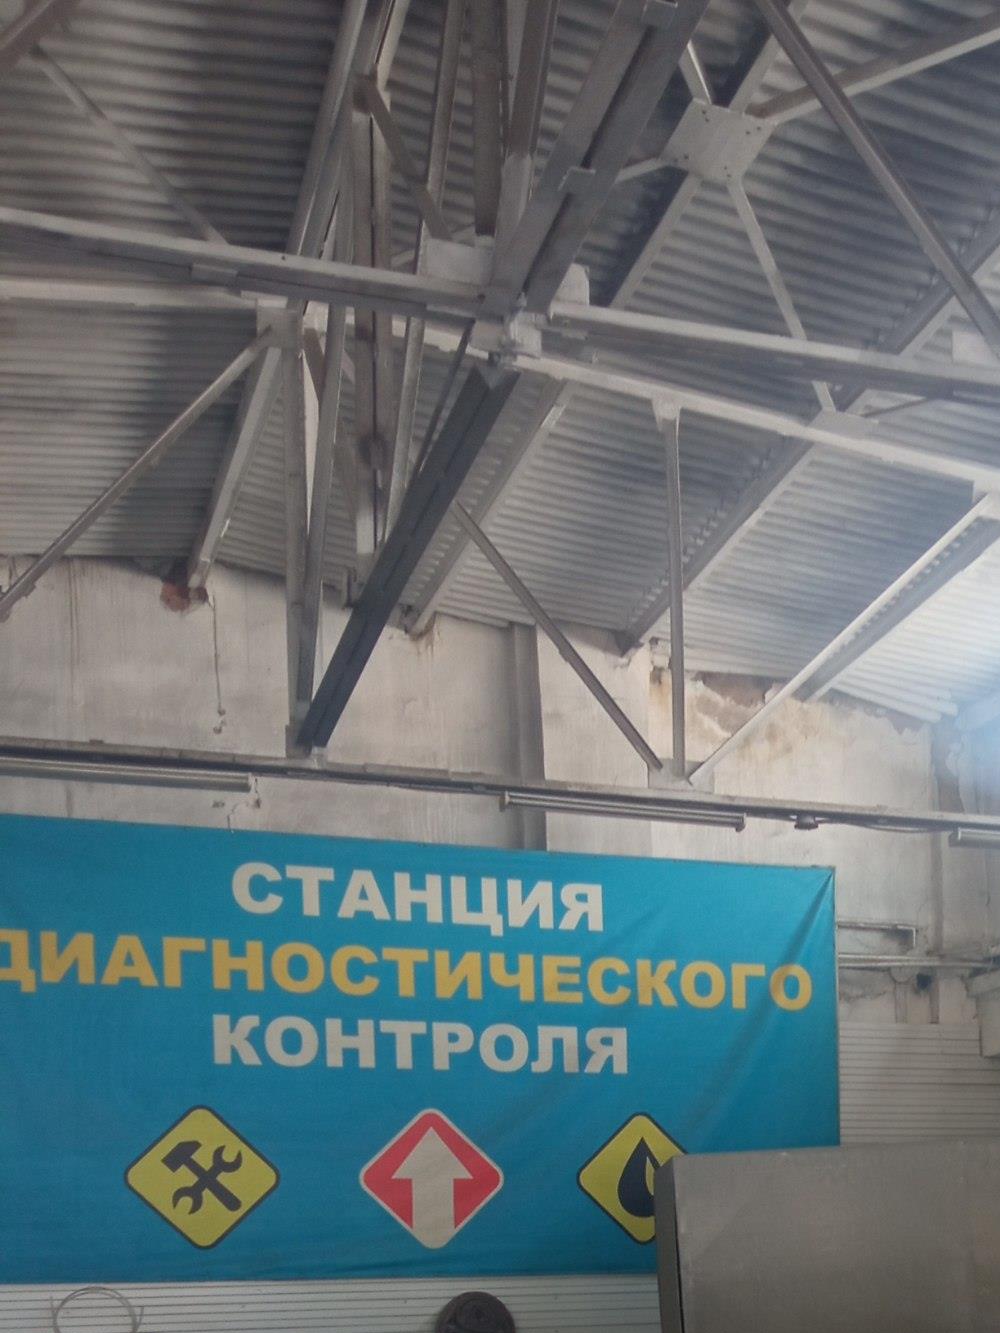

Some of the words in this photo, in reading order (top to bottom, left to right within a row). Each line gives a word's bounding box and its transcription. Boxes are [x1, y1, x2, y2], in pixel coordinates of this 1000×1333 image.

[231, 861, 604, 936] СТАНЦИЯ
[0, 928, 814, 1012] ДИАГНОСТИЧЕСКОГО
[212, 1013, 629, 1075] КОНТРОЛЯ
